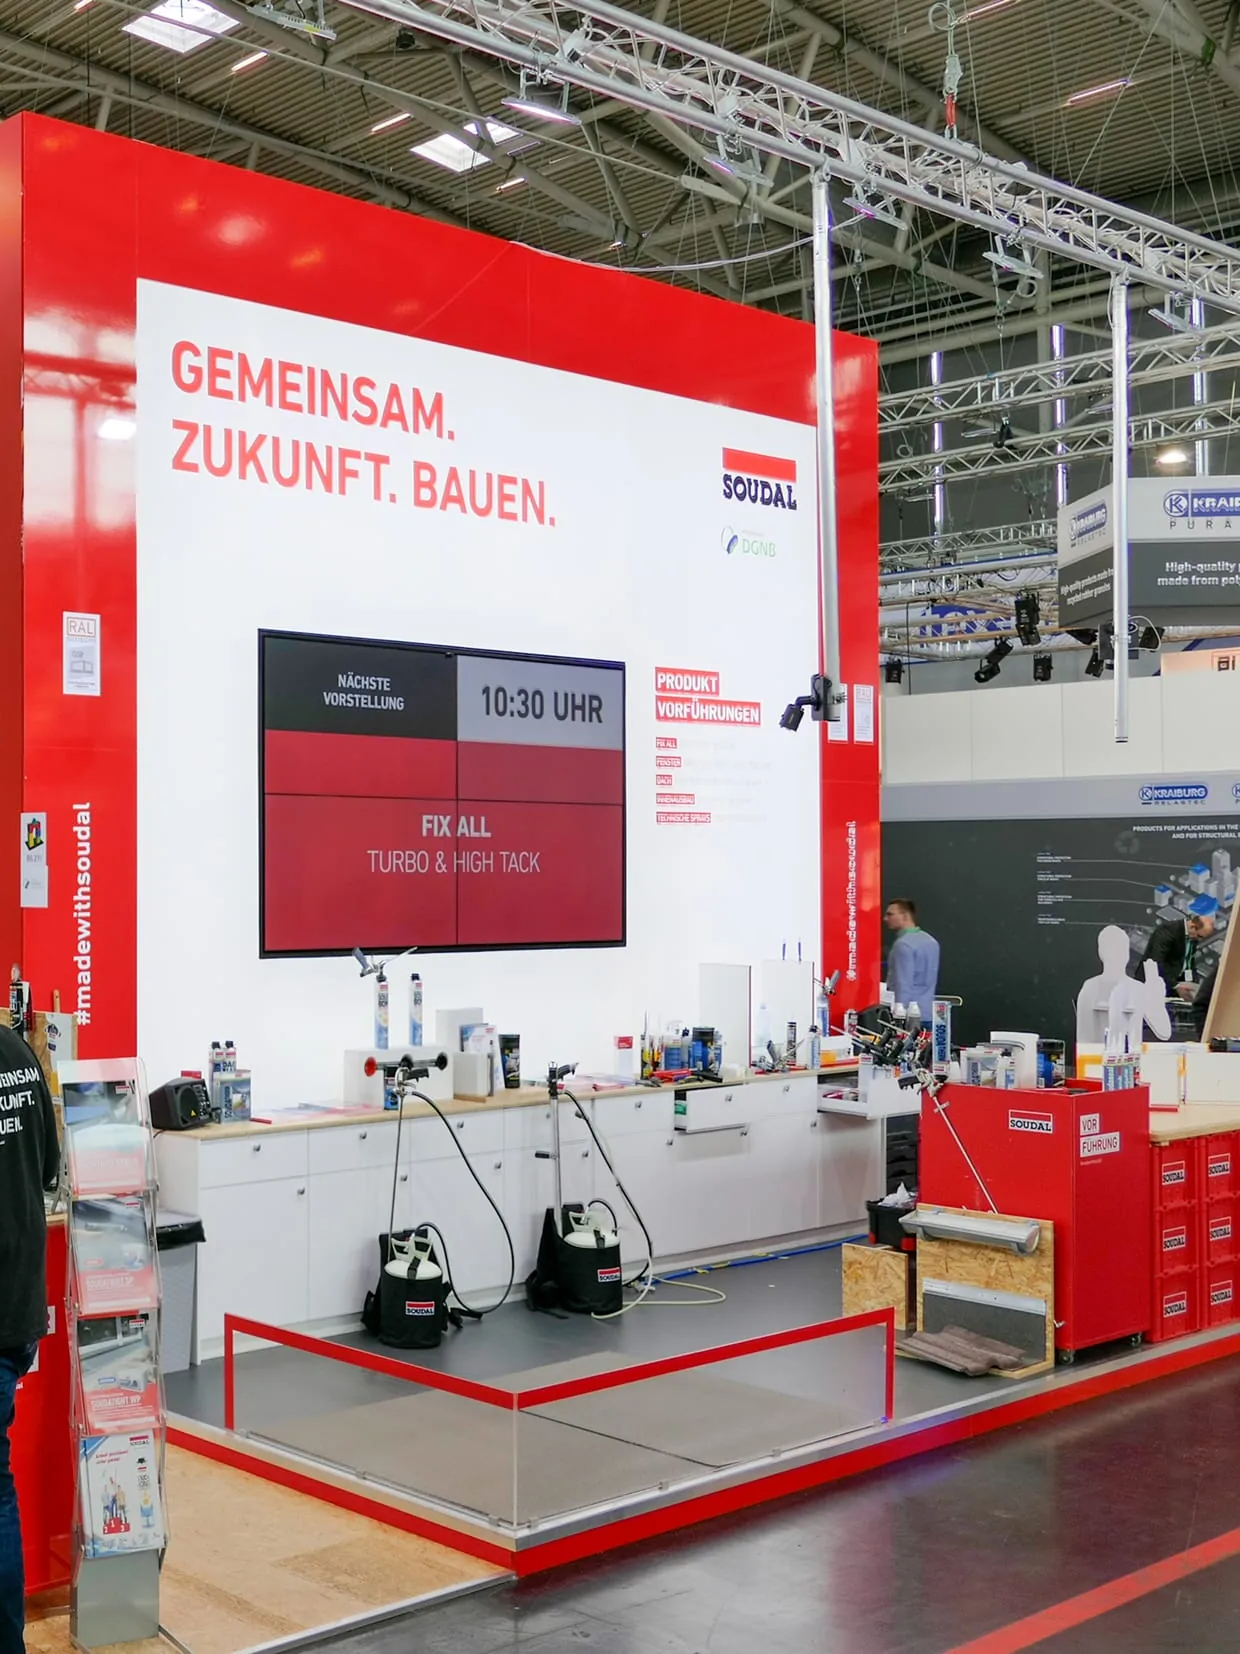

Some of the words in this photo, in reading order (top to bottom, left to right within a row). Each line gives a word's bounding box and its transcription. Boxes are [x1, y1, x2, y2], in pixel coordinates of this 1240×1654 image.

[171, 340, 456, 441] GEMEINSAM.
[171, 419, 397, 504] ZUKUNFT.
[412, 460, 557, 527] BAUEN.
[723, 474, 797, 510] SOUDAL
[742, 538, 776, 557] DGNB
[1165, 562, 1236, 573] High-quality
[1157, 576, 1189, 586] made
[1191, 575, 1219, 585] from
[69, 620, 94, 634] RAL
[338, 672, 391, 691] NÄCHSTE
[657, 673, 718, 693] PRODUKT
[323, 692, 405, 712] VORSTELLUNG
[482, 685, 545, 720] 10:30
[553, 692, 603, 724] UHR
[657, 698, 760, 723] VORFÜHRUNGEN
[1154, 788, 1206, 798] KRAIBURG
[422, 815, 452, 837] FIX
[456, 816, 492, 838] ALL
[367, 850, 429, 873] TURBO
[435, 851, 447, 873] &
[453, 851, 494, 873] HIGH
[500, 851, 541, 873] TACK
[73, 802, 91, 1025] #madewithsoudal
[1010, 1119, 1051, 1132] SOUDAL
[1082, 1118, 1097, 1131] VOR
[1162, 1171, 1184, 1183] SOUDAL
[1209, 1163, 1230, 1175] SOUDAL
[1210, 1227, 1230, 1239] SOUDAL
[1163, 1237, 1185, 1249] SOUDAL
[1211, 1291, 1232, 1303] SOUDAL
[1164, 1303, 1186, 1315] SOUDAL
